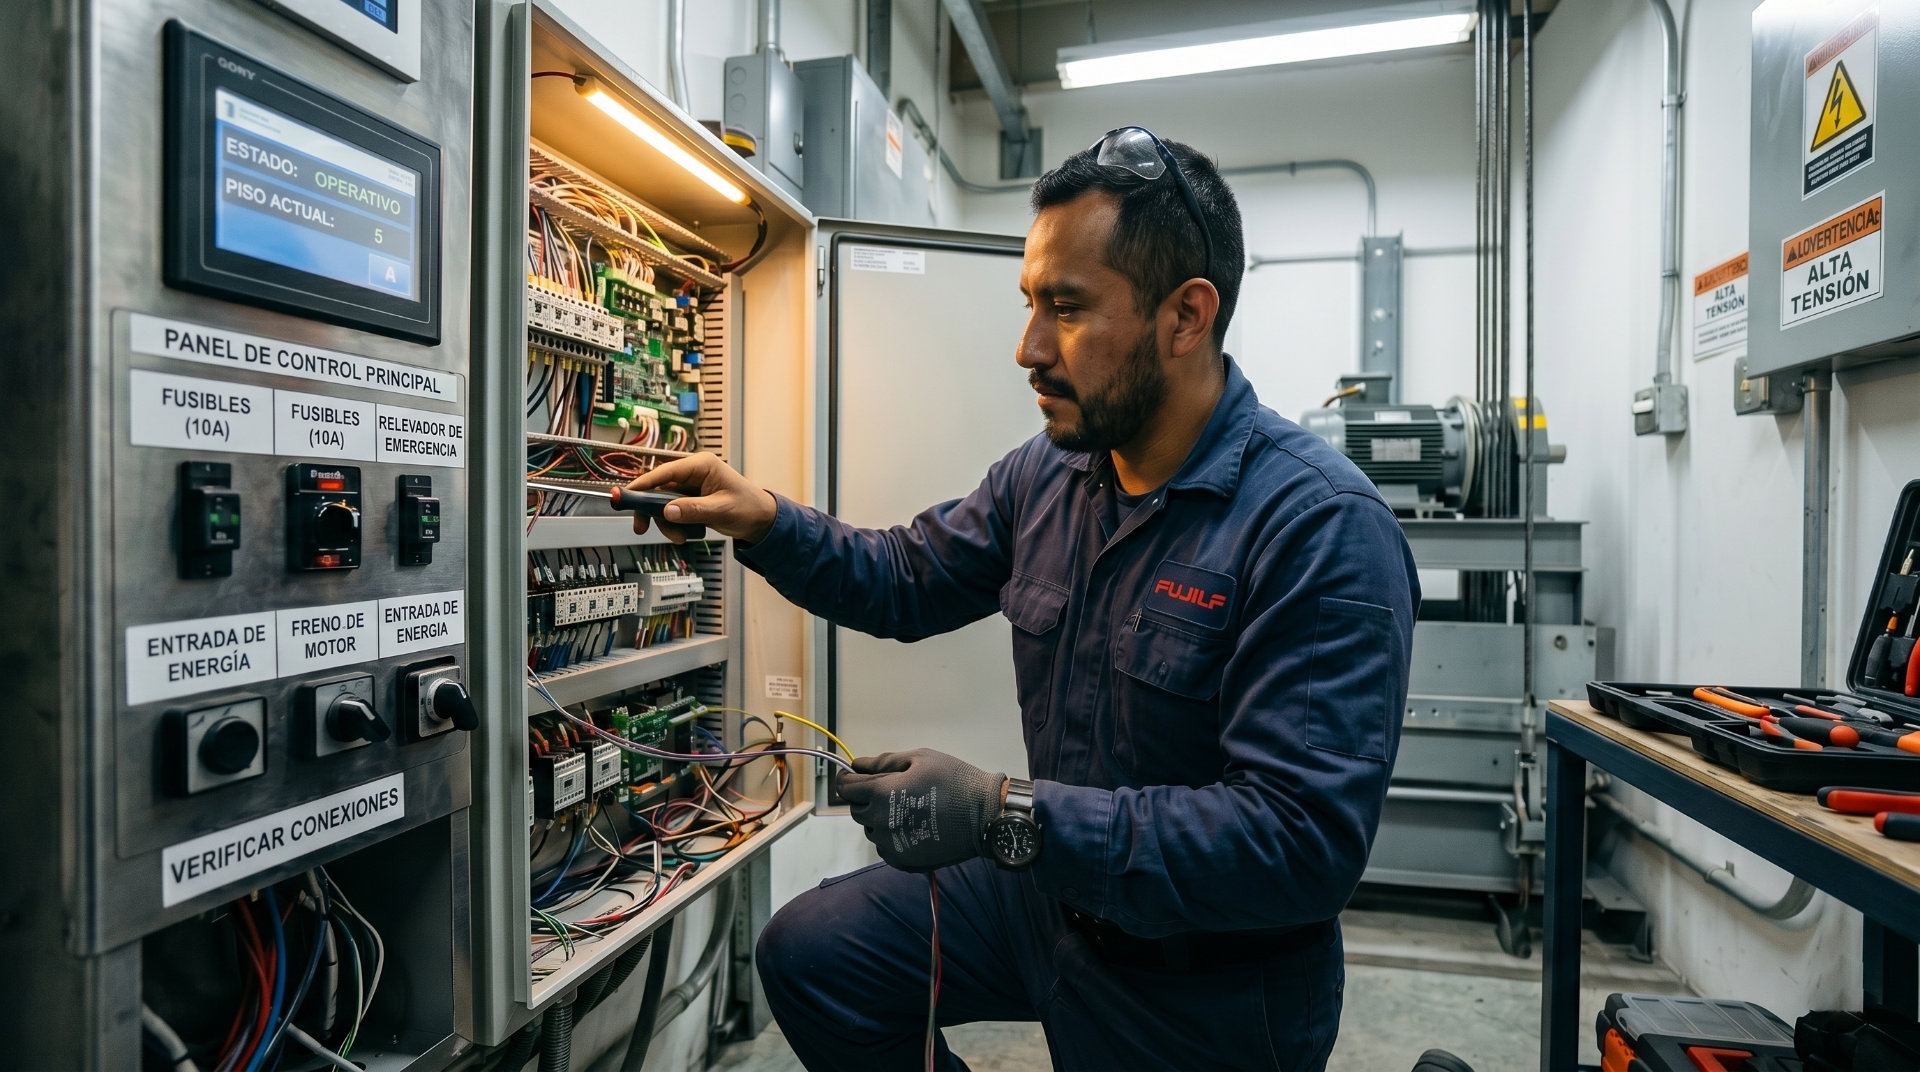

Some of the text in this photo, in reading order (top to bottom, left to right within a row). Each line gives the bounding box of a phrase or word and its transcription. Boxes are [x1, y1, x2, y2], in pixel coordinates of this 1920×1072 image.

[226, 137, 298, 178] ESTADO:
[315, 171, 401, 215] OPERATIVO
[226, 178, 383, 244] PISO ACTUAL: 5
[385, 266, 396, 283] A
[1807, 250, 1853, 286] ALTA
[1714, 283, 1736, 302] ALTA
[1790, 268, 1870, 314] TENSIÓN
[165, 328, 441, 394] PANEL DE CONTROL PRINCIPAL
[162, 388, 251, 414] FUSIBLES
[291, 403, 360, 426] FUSIBLES
[379, 415, 463, 438] RELEVADOR DE
[185, 417, 230, 442] (10A)
[309, 428, 345, 450] (10A)
[385, 437, 457, 458] EMERGENCIA
[1154, 578, 1227, 610] FUJILF
[291, 612, 364, 637] FRENO DE
[385, 600, 458, 624] ENTRADA DE
[147, 624, 266, 658] ENTRADA DE
[397, 622, 448, 644] ENERGIA
[305, 636, 356, 659] MOTOR
[168, 649, 251, 682] ENERGÍA
[171, 786, 399, 884] VERIFICAR CONEXIONES
